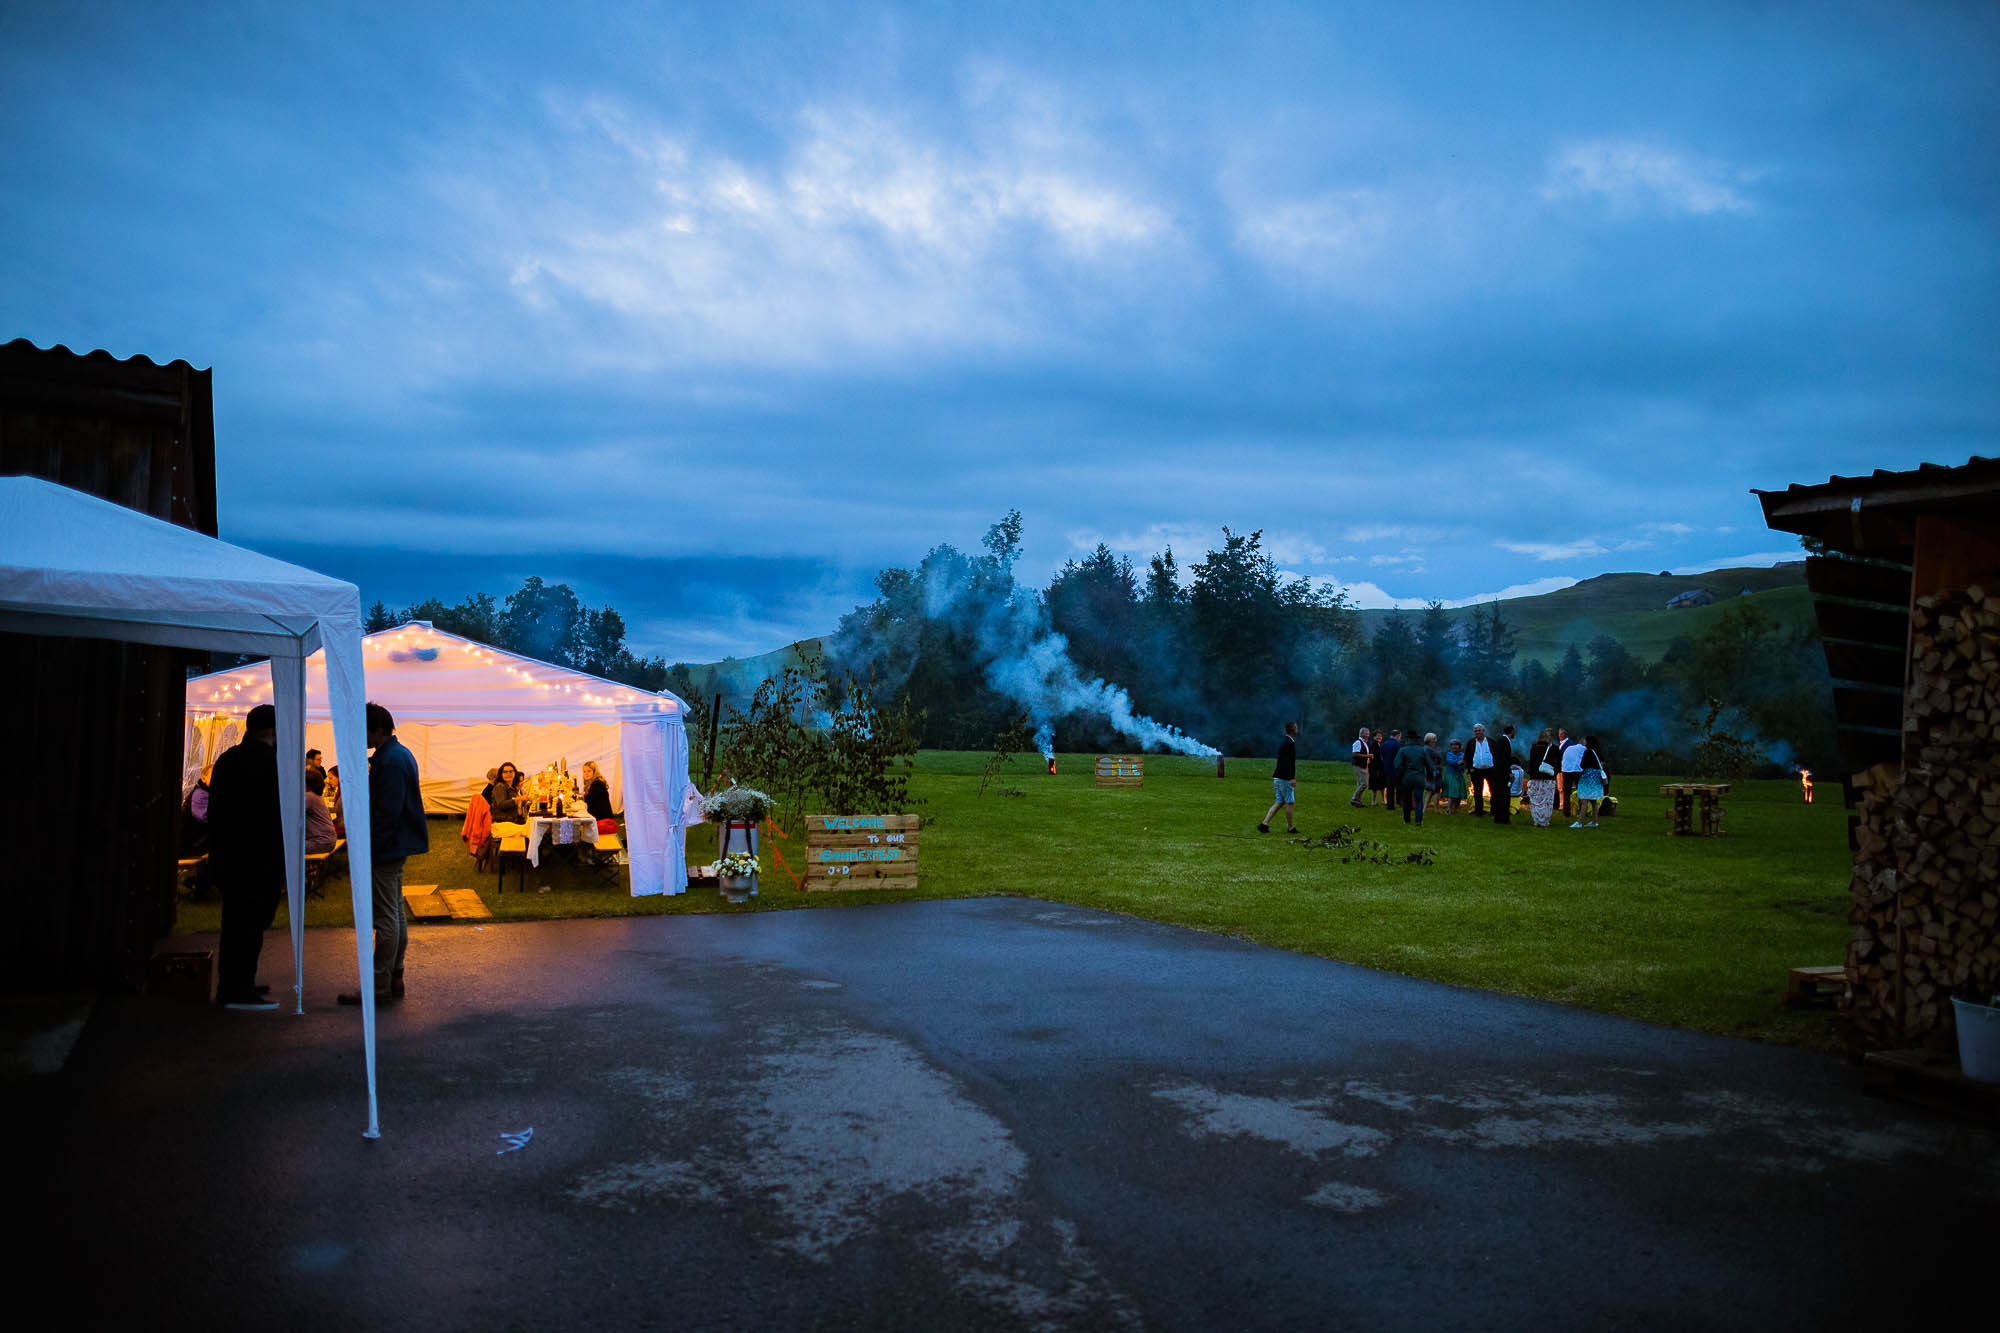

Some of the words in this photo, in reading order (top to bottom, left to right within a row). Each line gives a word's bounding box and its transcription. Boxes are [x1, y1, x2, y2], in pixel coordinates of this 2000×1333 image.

[824, 817, 886, 830] WELCOME
[886, 834, 905, 844] OUR
[819, 849, 903, 862] SOMMERFEST
